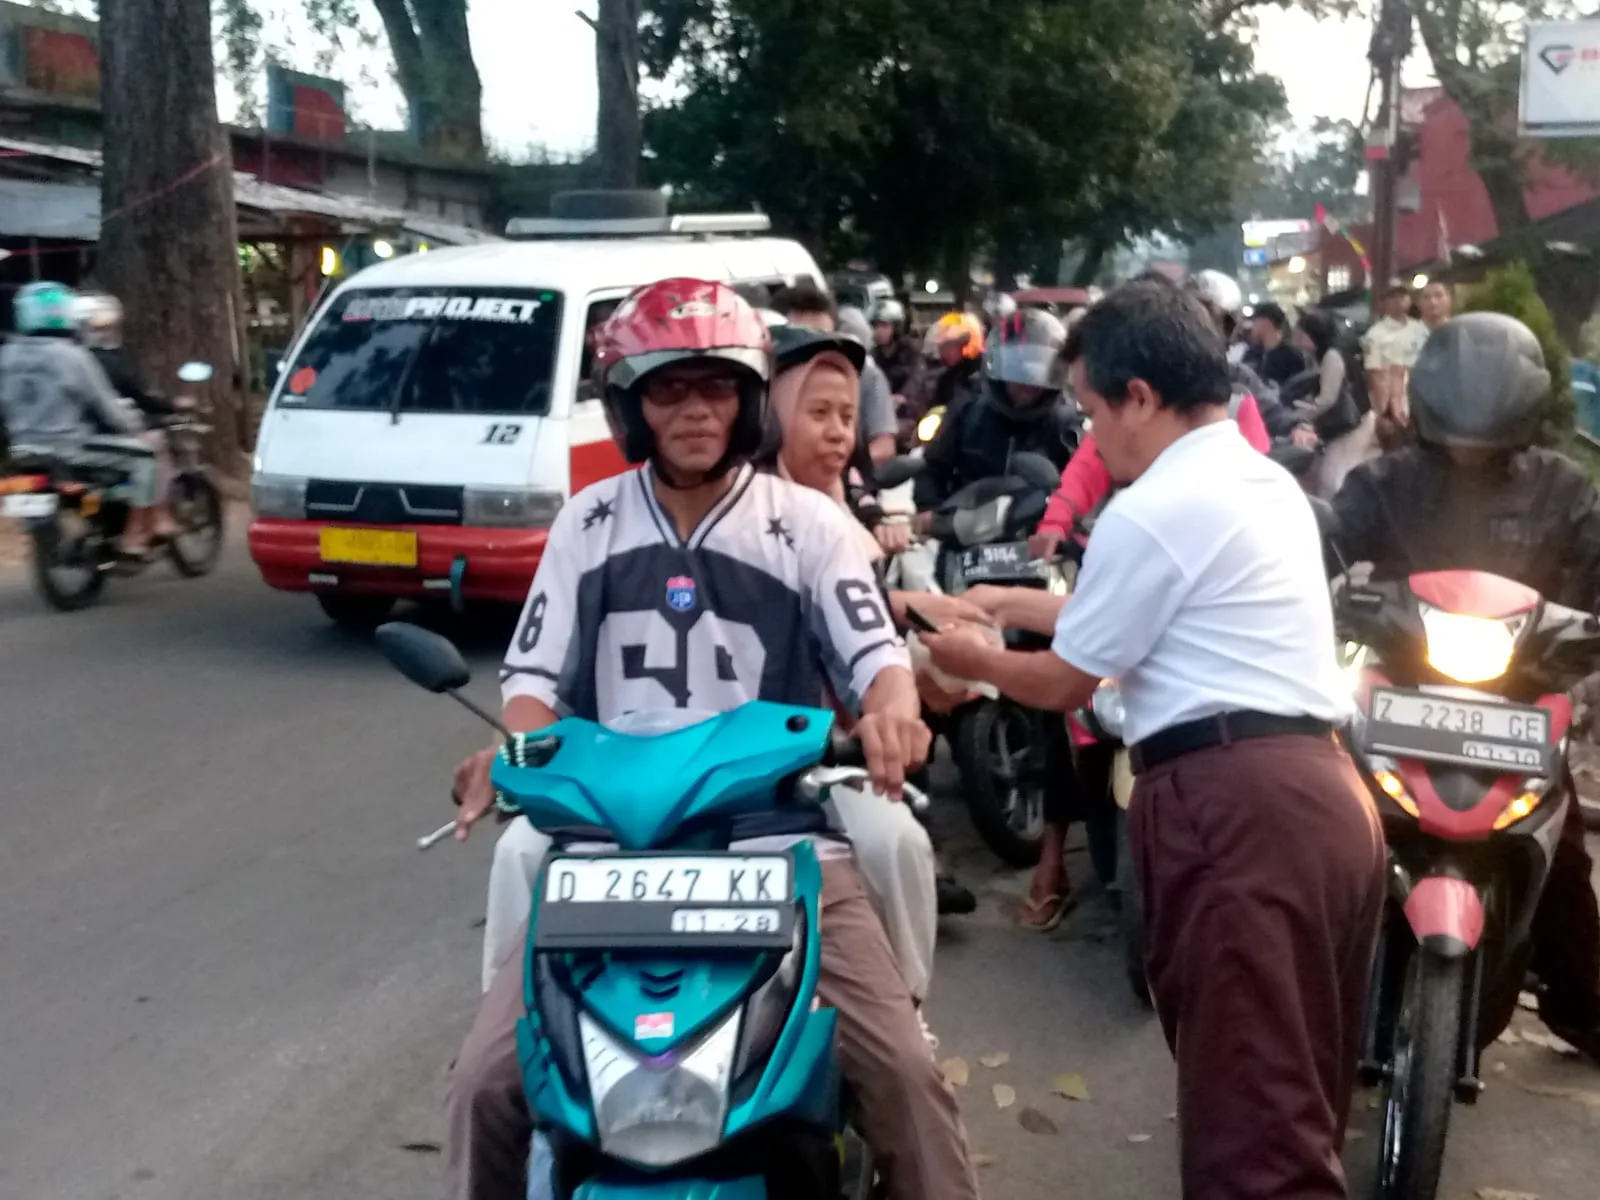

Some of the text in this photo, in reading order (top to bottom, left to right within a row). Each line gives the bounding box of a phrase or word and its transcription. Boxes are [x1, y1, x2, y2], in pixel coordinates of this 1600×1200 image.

[476, 422, 521, 445] 12
[517, 590, 548, 653] 8
[835, 578, 885, 632] 6
[1379, 697, 1392, 721] Z
[1420, 704, 1484, 734] 2238
[559, 867, 772, 901] D 2647 KK
